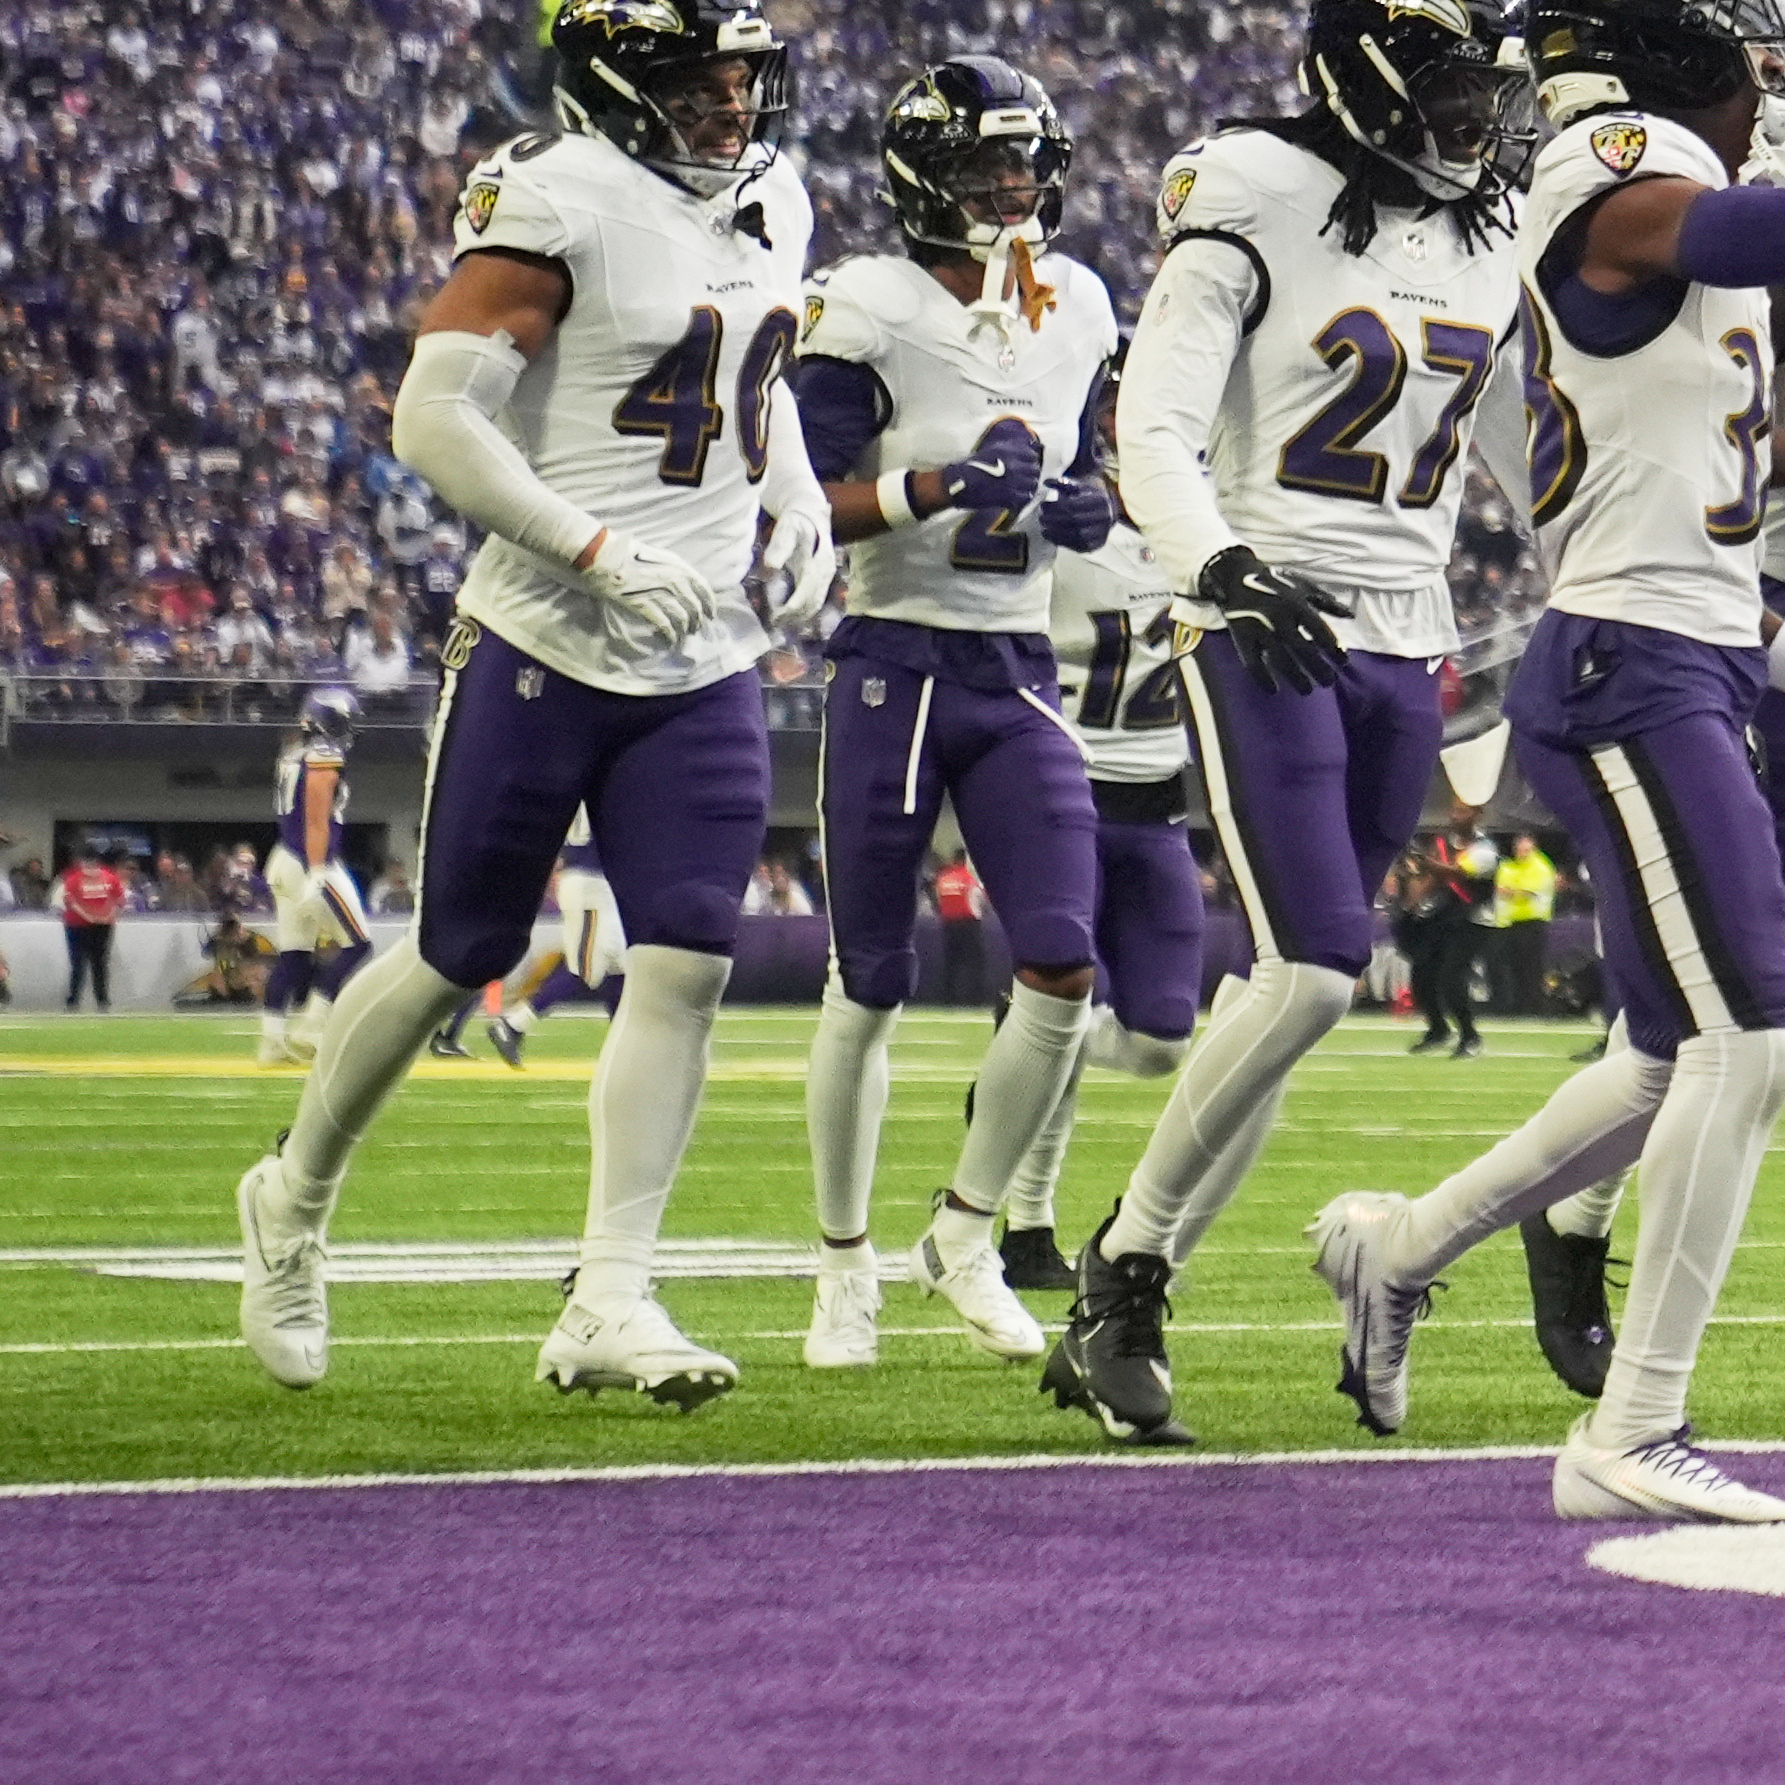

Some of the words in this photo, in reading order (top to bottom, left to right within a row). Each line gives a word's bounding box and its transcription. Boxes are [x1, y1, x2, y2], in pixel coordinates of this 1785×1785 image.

[705, 280, 755, 294] RAVENS
[1389, 290, 1449, 309] RAVENS
[612, 304, 800, 488] 40
[985, 397, 1035, 409] RAVENS
[1276, 305, 1494, 509] 27
